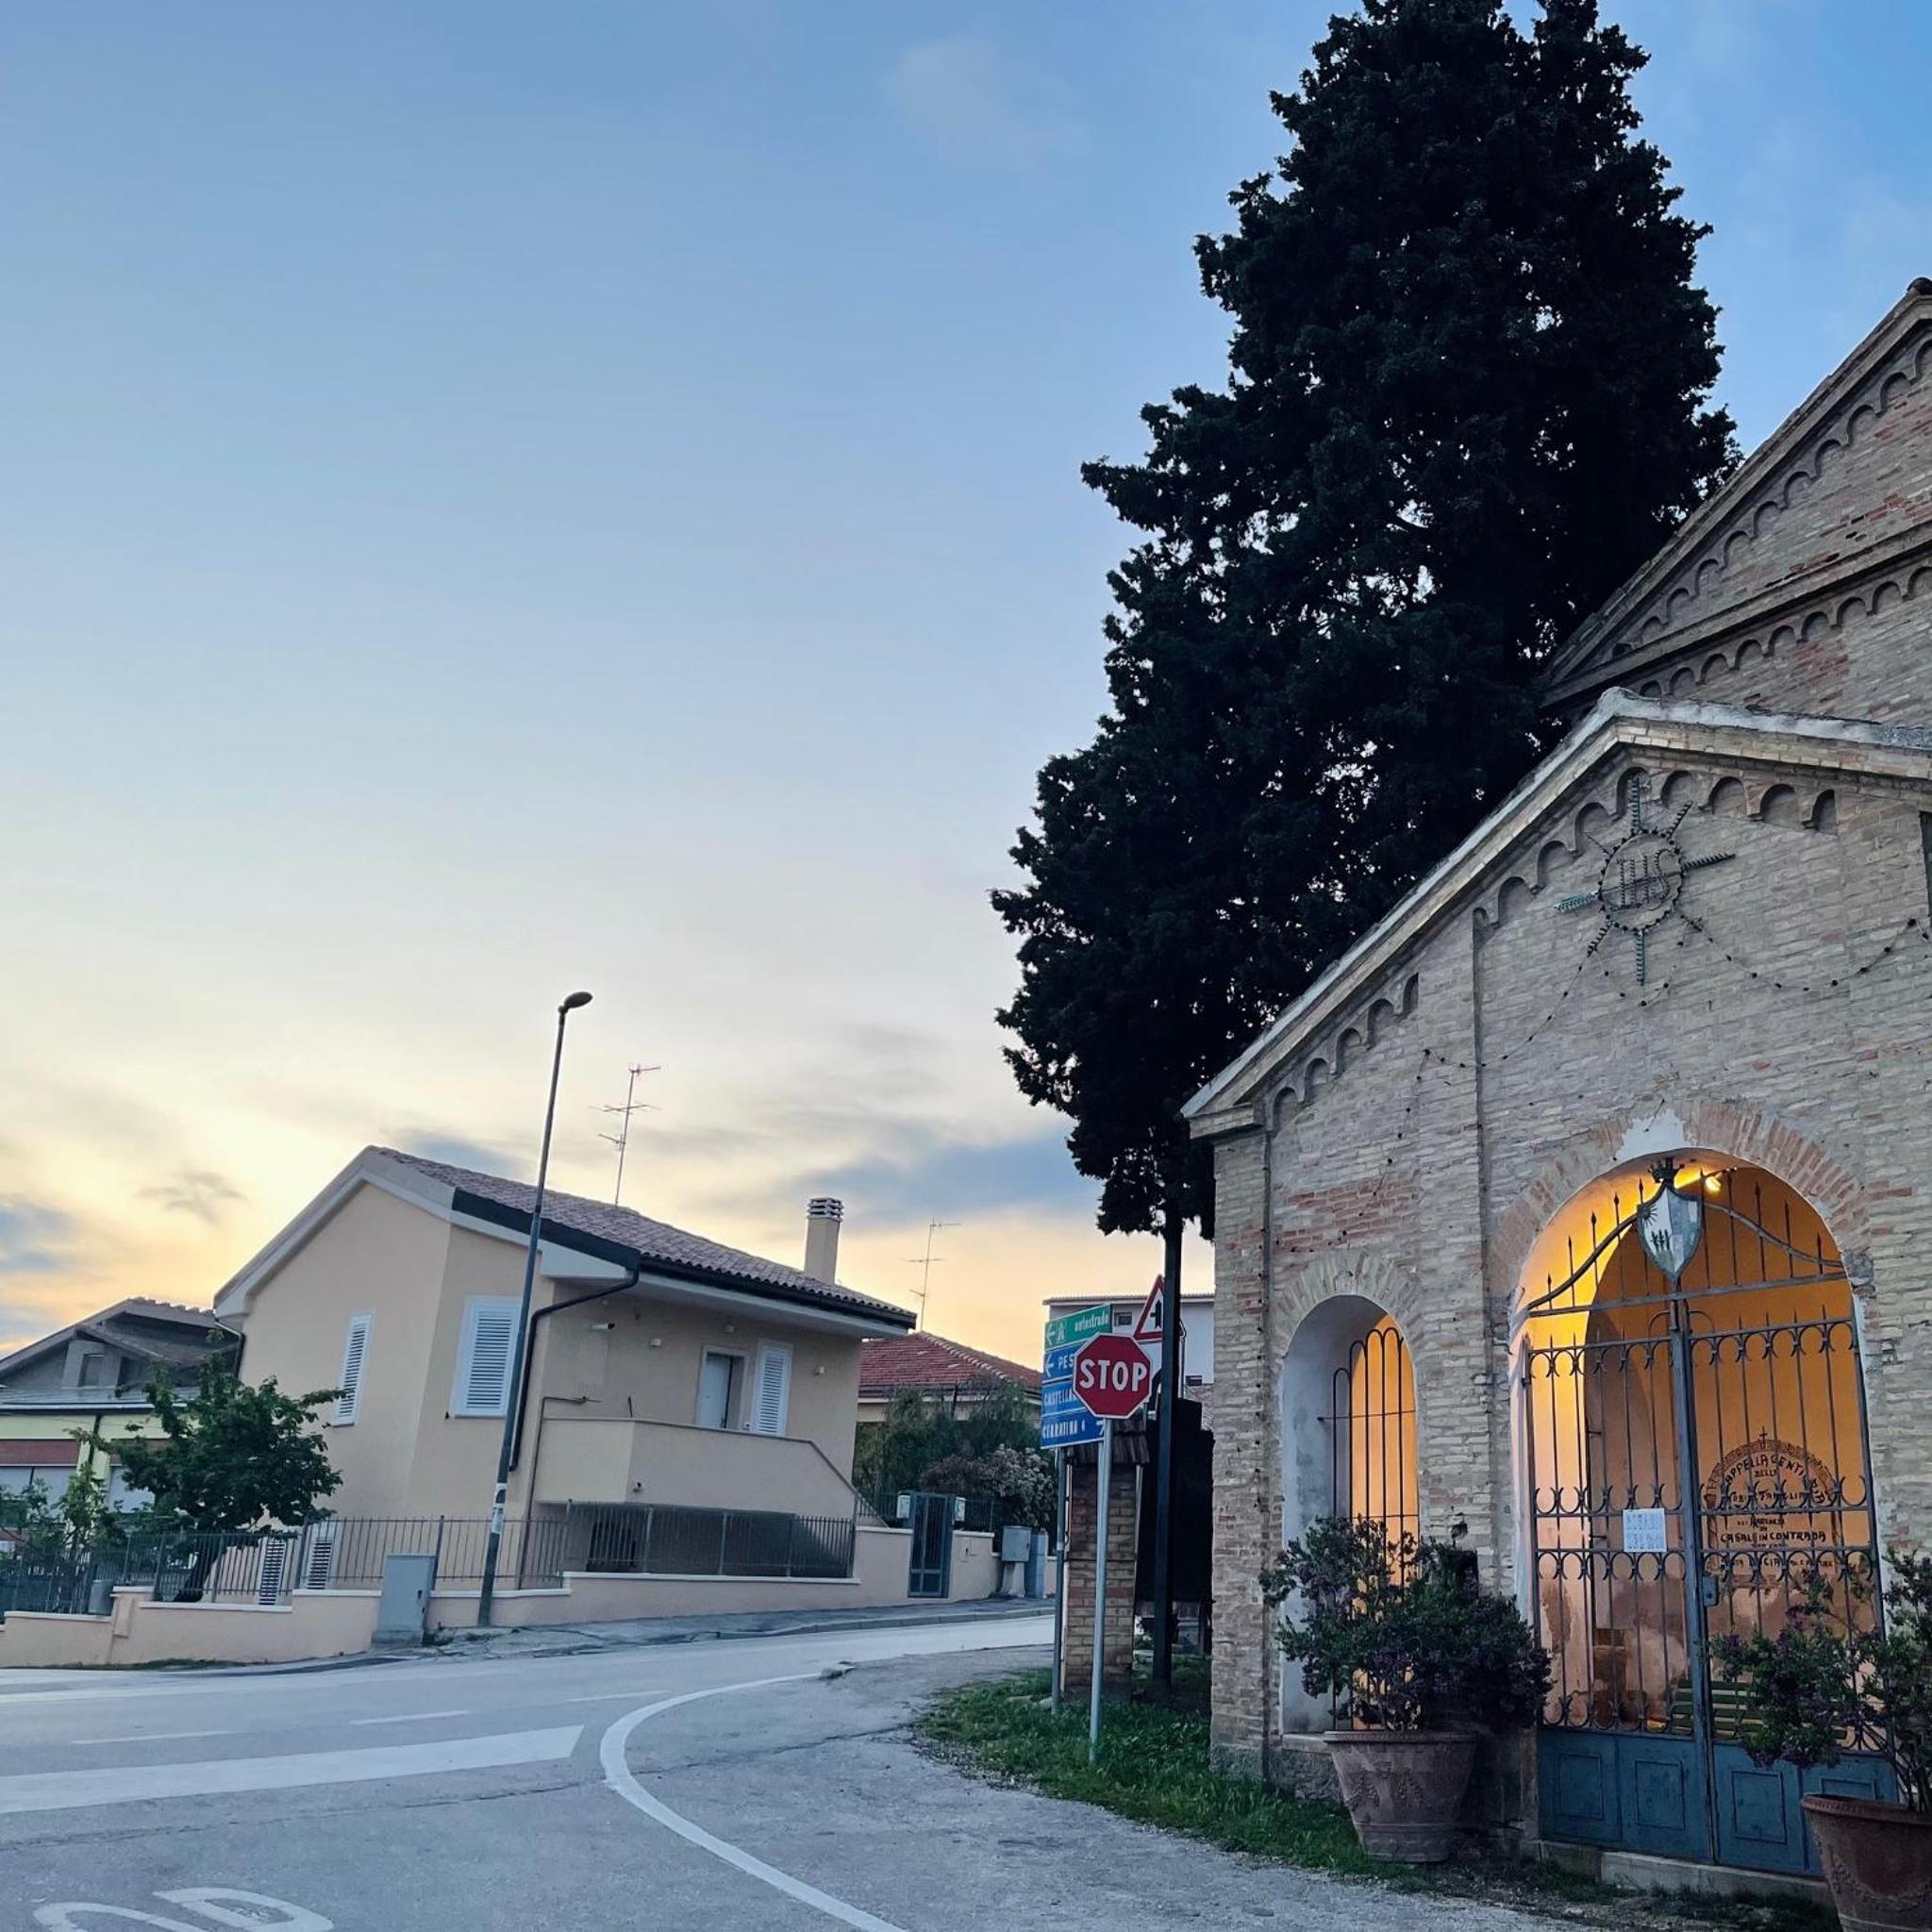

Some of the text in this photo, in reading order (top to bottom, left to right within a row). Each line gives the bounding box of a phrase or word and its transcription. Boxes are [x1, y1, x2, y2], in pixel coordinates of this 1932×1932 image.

[1074, 1310, 1108, 1332] autostrada
[1058, 1353, 1074, 1371] PES
[1079, 1358, 1148, 1392] STOP
[1043, 1388, 1078, 1407] CASTELLA
